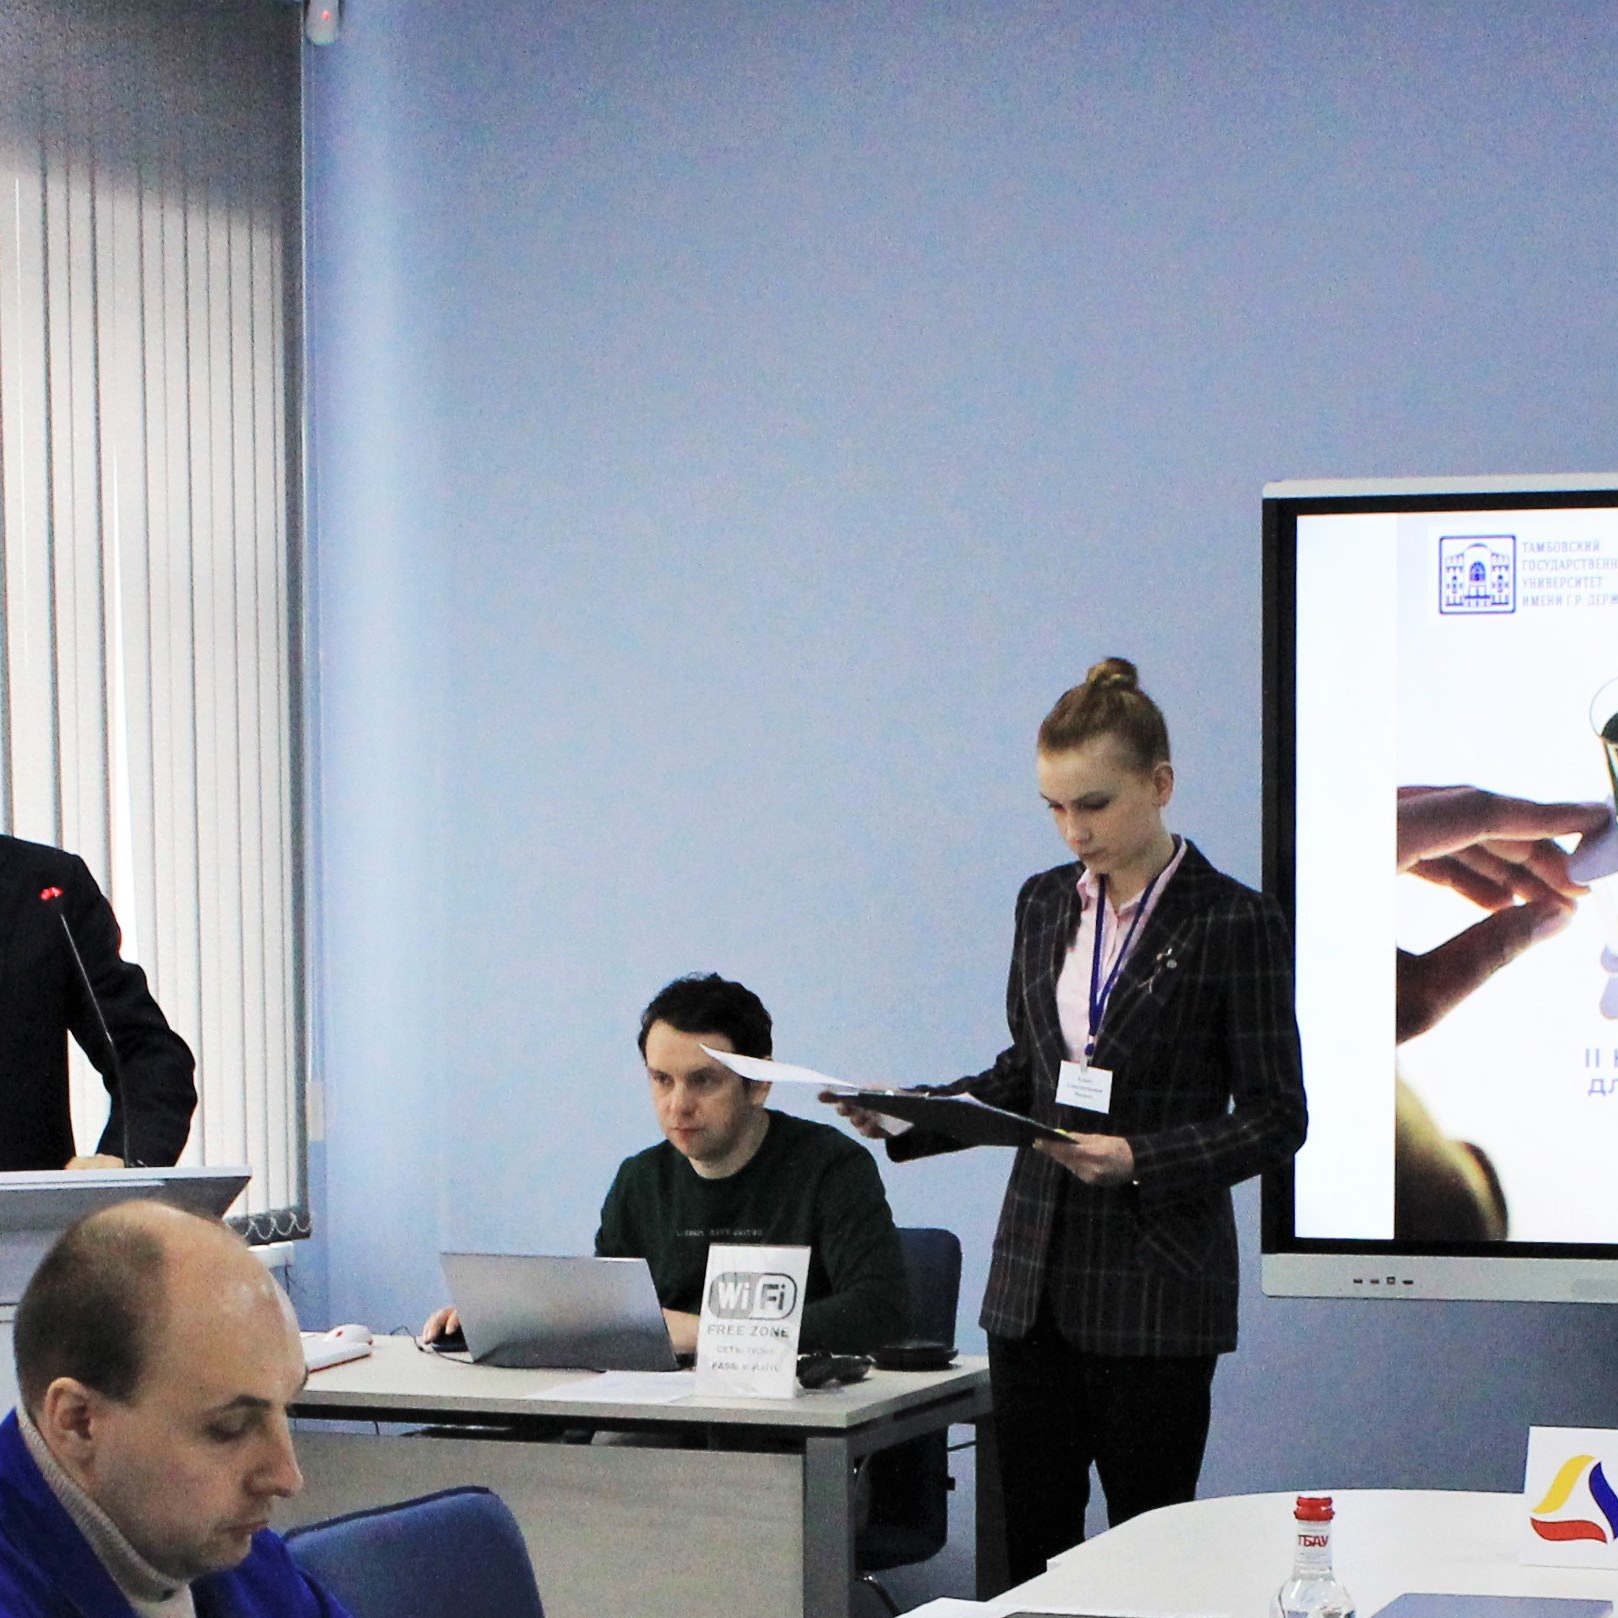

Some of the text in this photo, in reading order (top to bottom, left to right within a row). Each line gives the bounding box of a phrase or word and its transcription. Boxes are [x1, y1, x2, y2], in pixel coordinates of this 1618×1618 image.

[1522, 539, 1601, 554] ТАМБОВСКИЙ
[1522, 576, 1603, 589] УНИВЕРСИТЕТ
[1522, 595, 1558, 607] ИМЕНИ
[707, 1324, 789, 1337] FREE ZONE
[1298, 1534, 1329, 1547] ТБАУ
